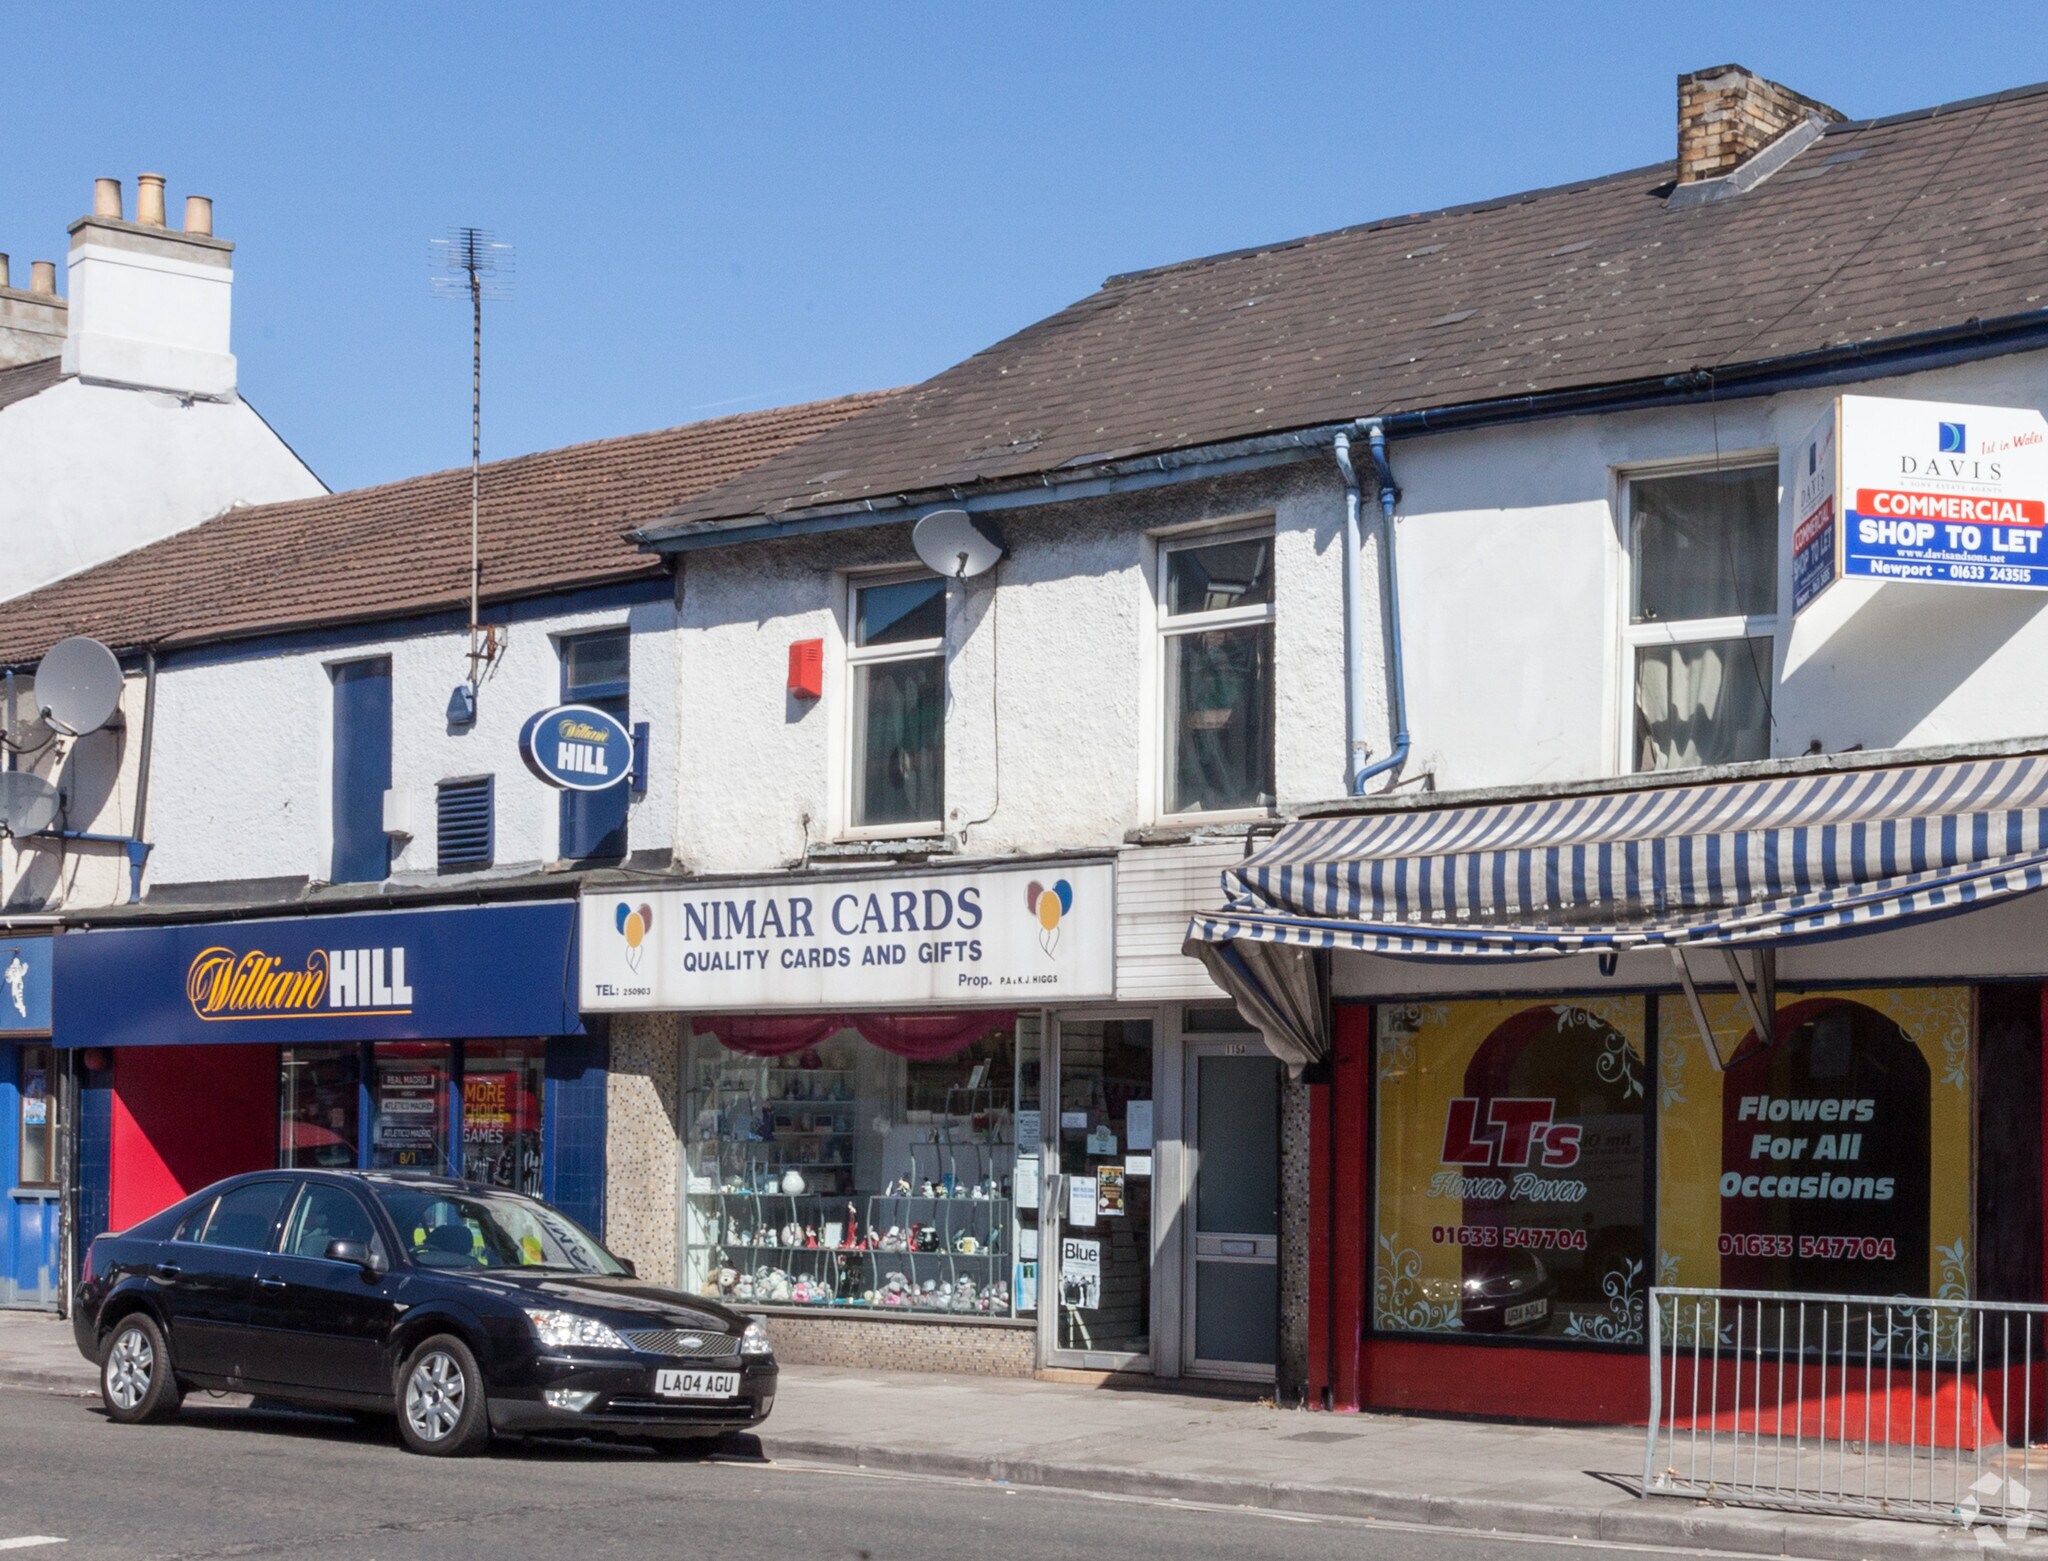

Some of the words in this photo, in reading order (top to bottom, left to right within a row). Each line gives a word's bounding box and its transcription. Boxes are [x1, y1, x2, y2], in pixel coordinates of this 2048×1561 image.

[2000, 439, 2010, 452] in
[2013, 431, 2044, 448] Wales
[1900, 455, 2002, 481] DAVIS
[1936, 483, 1966, 492] ESTATE
[1971, 486, 2003, 495] AGENTS
[1873, 493, 2030, 523] COMMERCIAL
[1859, 519, 1936, 547] SHOP
[1945, 525, 1981, 550] TO
[1992, 528, 2043, 554] LET
[1896, 548, 2006, 564] www.davisandsons.net
[1870, 560, 1933, 578] Newport
[1949, 565, 1985, 580] 01633
[1990, 567, 2032, 582] 243515
[558, 719, 610, 743] William
[557, 742, 609, 775] HILL
[683, 897, 816, 941] NIMAR
[831, 887, 983, 936] CARDS
[683, 949, 770, 972] QUALITY
[780, 946, 851, 969] CARDS
[861, 944, 906, 966] AND
[918, 940, 983, 963] GIFTS
[187, 946, 329, 1015] William
[329, 947, 413, 1008] HILL
[595, 984, 619, 997] TEL:
[958, 973, 992, 989] Prop.
[1032, 974, 1058, 984] HIGGS
[386, 1075, 402, 1085] REAL
[403, 1075, 428, 1085] MADRID
[464, 1084, 506, 1102] MORE
[410, 1101, 433, 1110] MADRID
[464, 1103, 505, 1118] CHOICE
[1738, 1095, 1875, 1122] Flowers
[410, 1129, 432, 1138] MADRID
[463, 1128, 504, 1144] GAMES
[1440, 1097, 1583, 1168] LT's
[1750, 1134, 1808, 1160] For
[1812, 1133, 1862, 1160] All
[400, 1152, 416, 1165] 8/1
[1427, 1170, 1507, 1200] Flower
[1510, 1172, 1588, 1203] Power
[1719, 1171, 1896, 1200] Occasions
[1431, 1225, 1499, 1247] 01633
[1502, 1226, 1588, 1251] 547704
[1717, 1233, 1793, 1257] 01633
[1799, 1235, 1896, 1260] 547704
[1065, 1242, 1098, 1262] Blue
[662, 1373, 702, 1392] LA04
[705, 1375, 734, 1393] AGU
